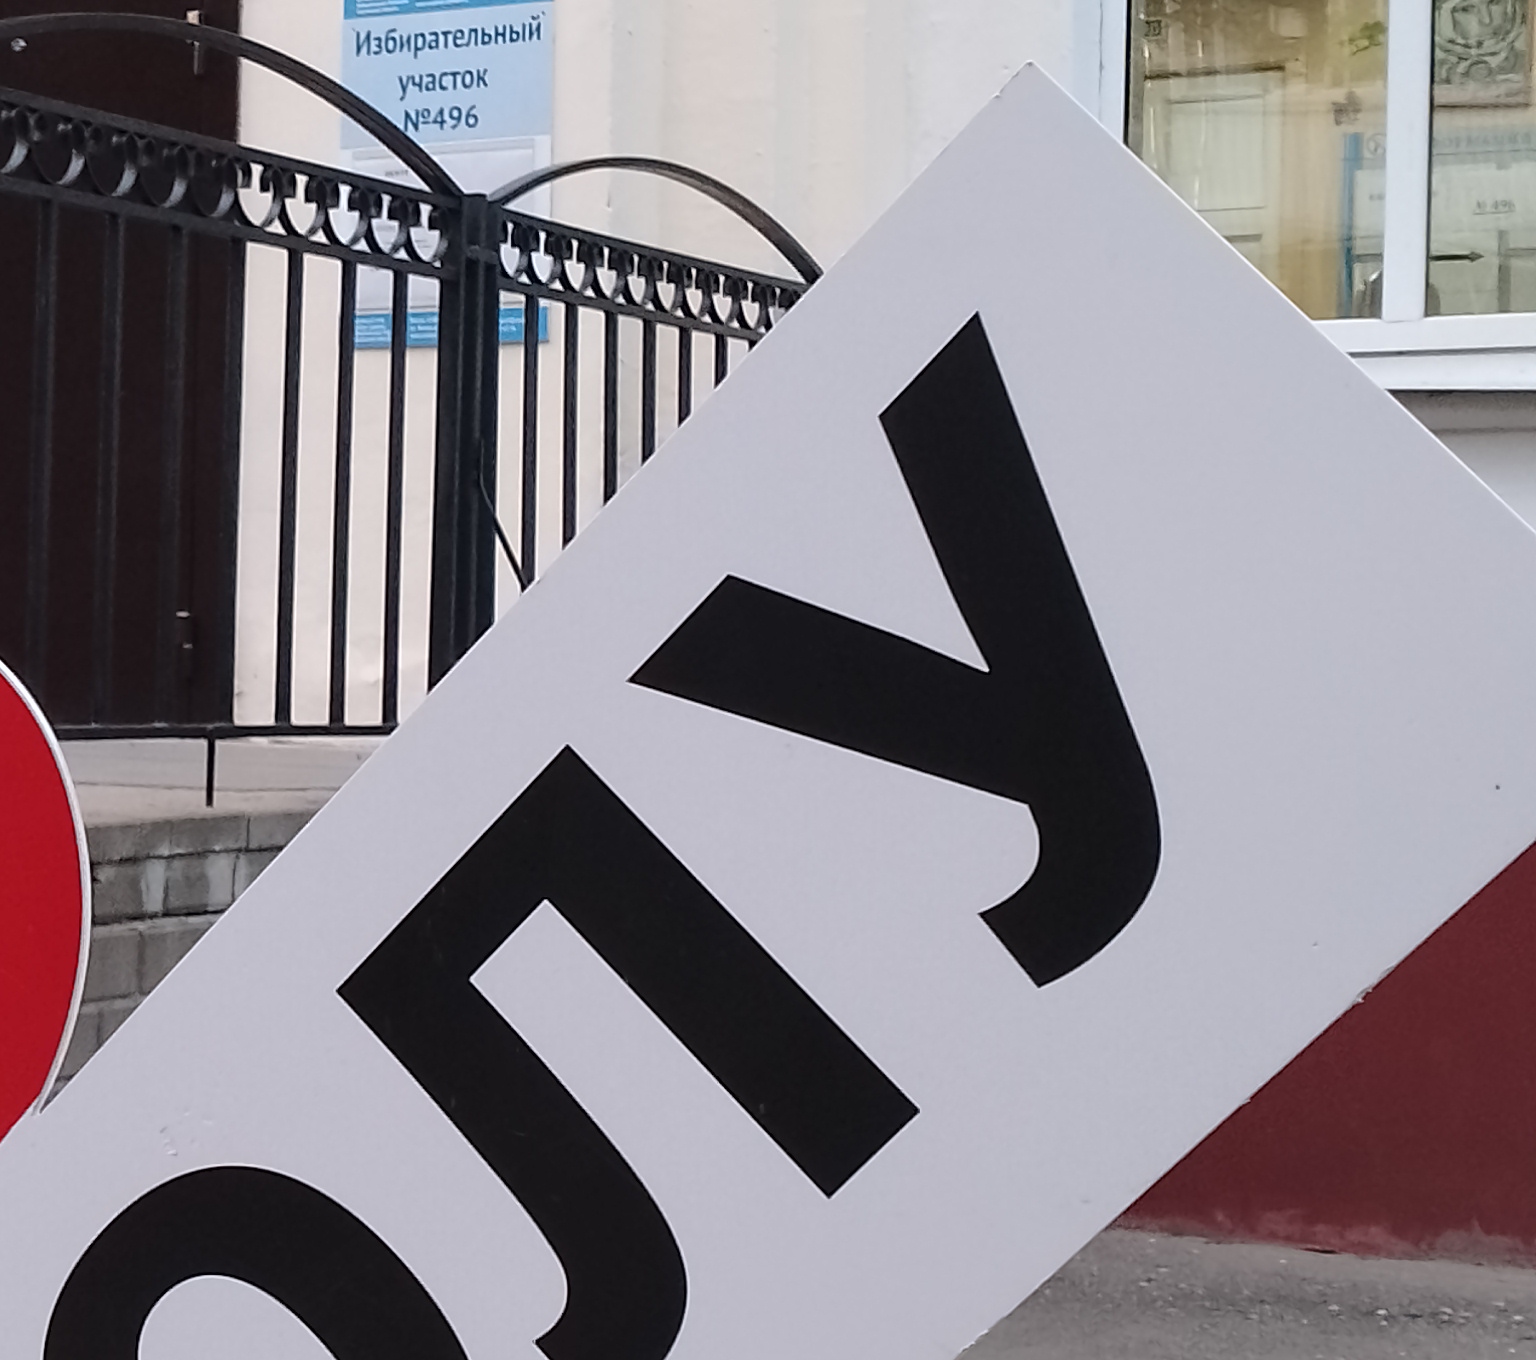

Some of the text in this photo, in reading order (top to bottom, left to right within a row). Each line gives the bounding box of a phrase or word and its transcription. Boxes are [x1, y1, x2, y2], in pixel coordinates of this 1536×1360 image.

[355, 14, 542, 59] Избирательный
[398, 68, 489, 102] участок
[403, 105, 479, 132] №496
